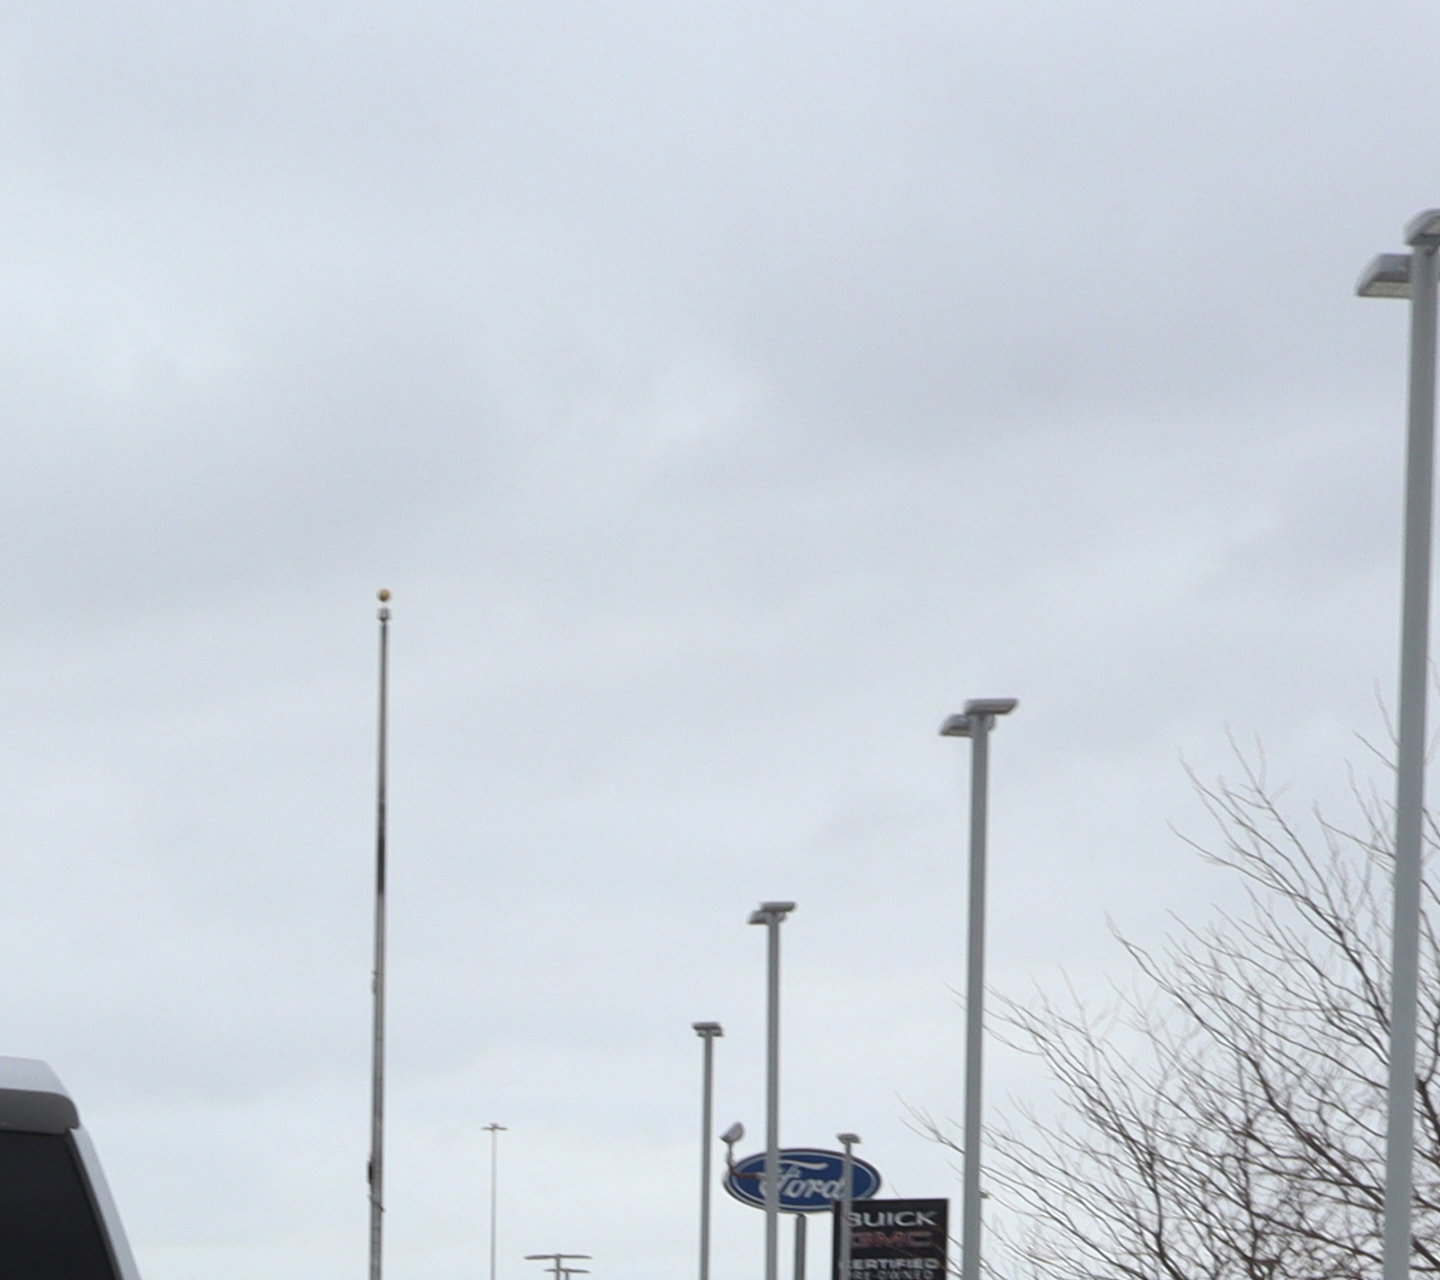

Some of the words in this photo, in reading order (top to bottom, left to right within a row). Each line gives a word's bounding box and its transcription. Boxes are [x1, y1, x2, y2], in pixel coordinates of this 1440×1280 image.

[758, 1160, 851, 1199] Ford
[839, 1257, 939, 1270] ERTIFIED
[841, 1270, 934, 1280] RE-OWNED
